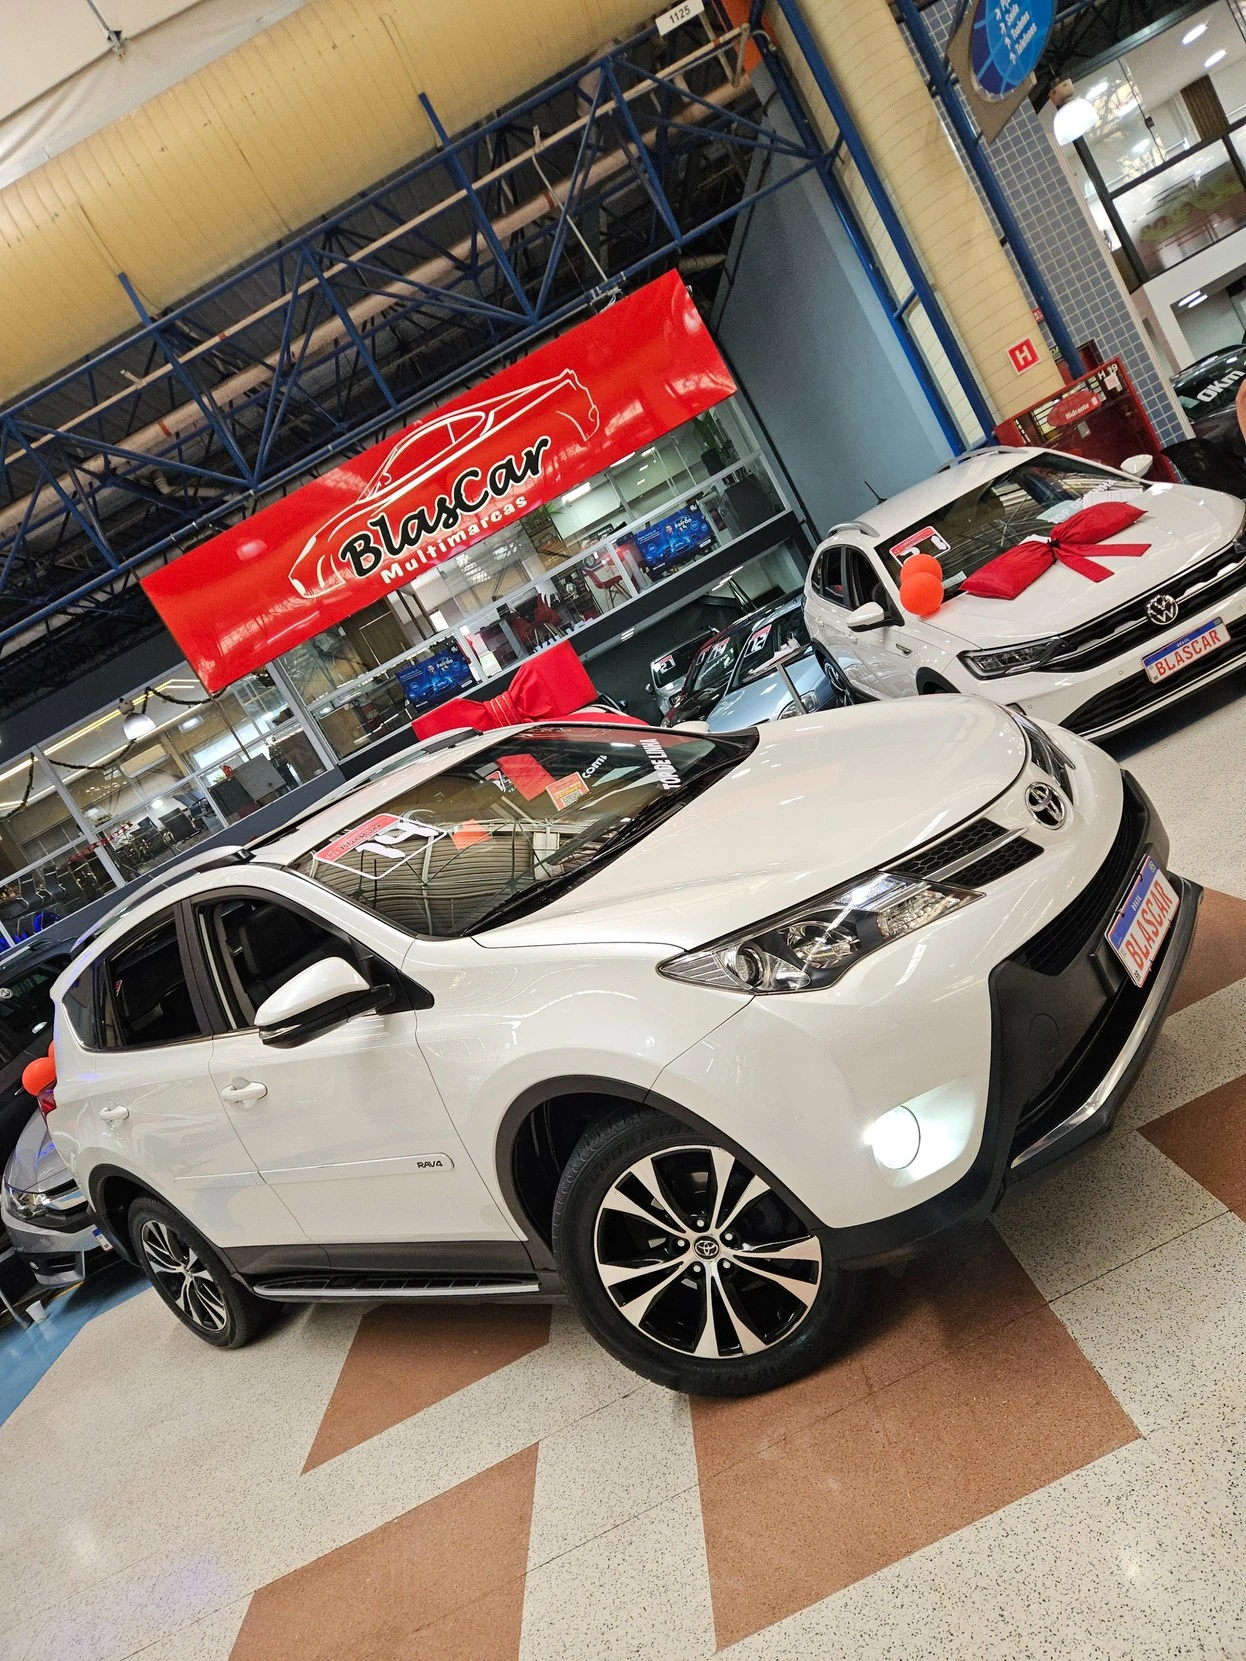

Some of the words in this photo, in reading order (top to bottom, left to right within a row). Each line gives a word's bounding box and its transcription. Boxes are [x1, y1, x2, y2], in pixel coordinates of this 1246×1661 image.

[669, 5, 692, 24] 1125
[1015, 345, 1032, 366] H
[1065, 402, 1091, 421] Hidrante
[339, 436, 551, 579] BlasCar
[380, 495, 529, 585] Multimarcas
[1155, 629, 1221, 677] BLASCAR
[658, 771, 681, 790] TOP
[1125, 880, 1173, 972] BLASCAR
[416, 1160, 443, 1169] RAV4
